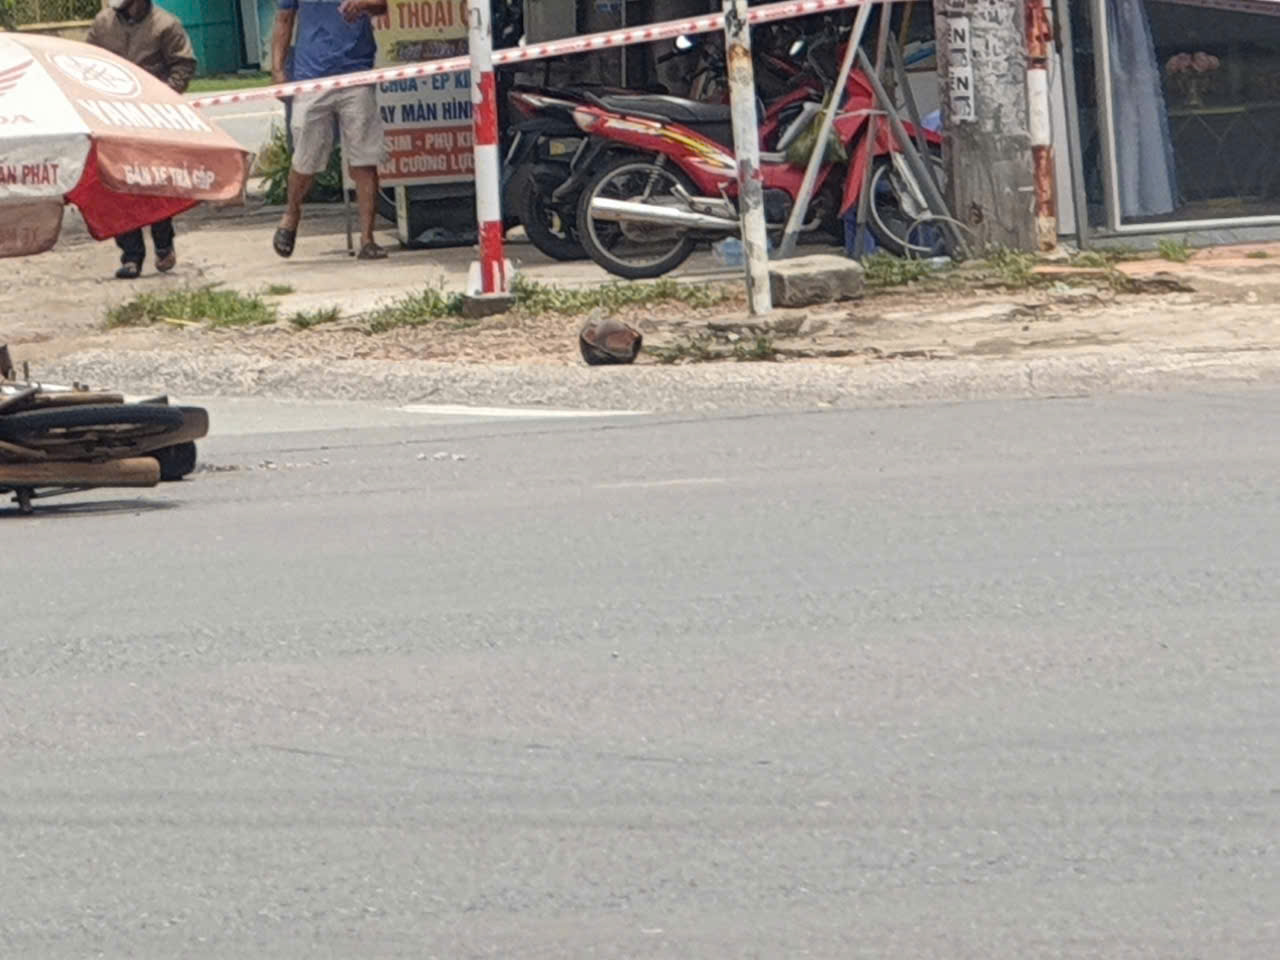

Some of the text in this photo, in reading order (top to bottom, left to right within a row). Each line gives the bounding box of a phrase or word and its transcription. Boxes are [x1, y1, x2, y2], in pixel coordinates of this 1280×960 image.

[396, 0, 454, 34] THOẠI
[76, 99, 214, 133] YAMAHA
[401, 97, 439, 123] MÀN
[21, 157, 60, 186] PHÁT
